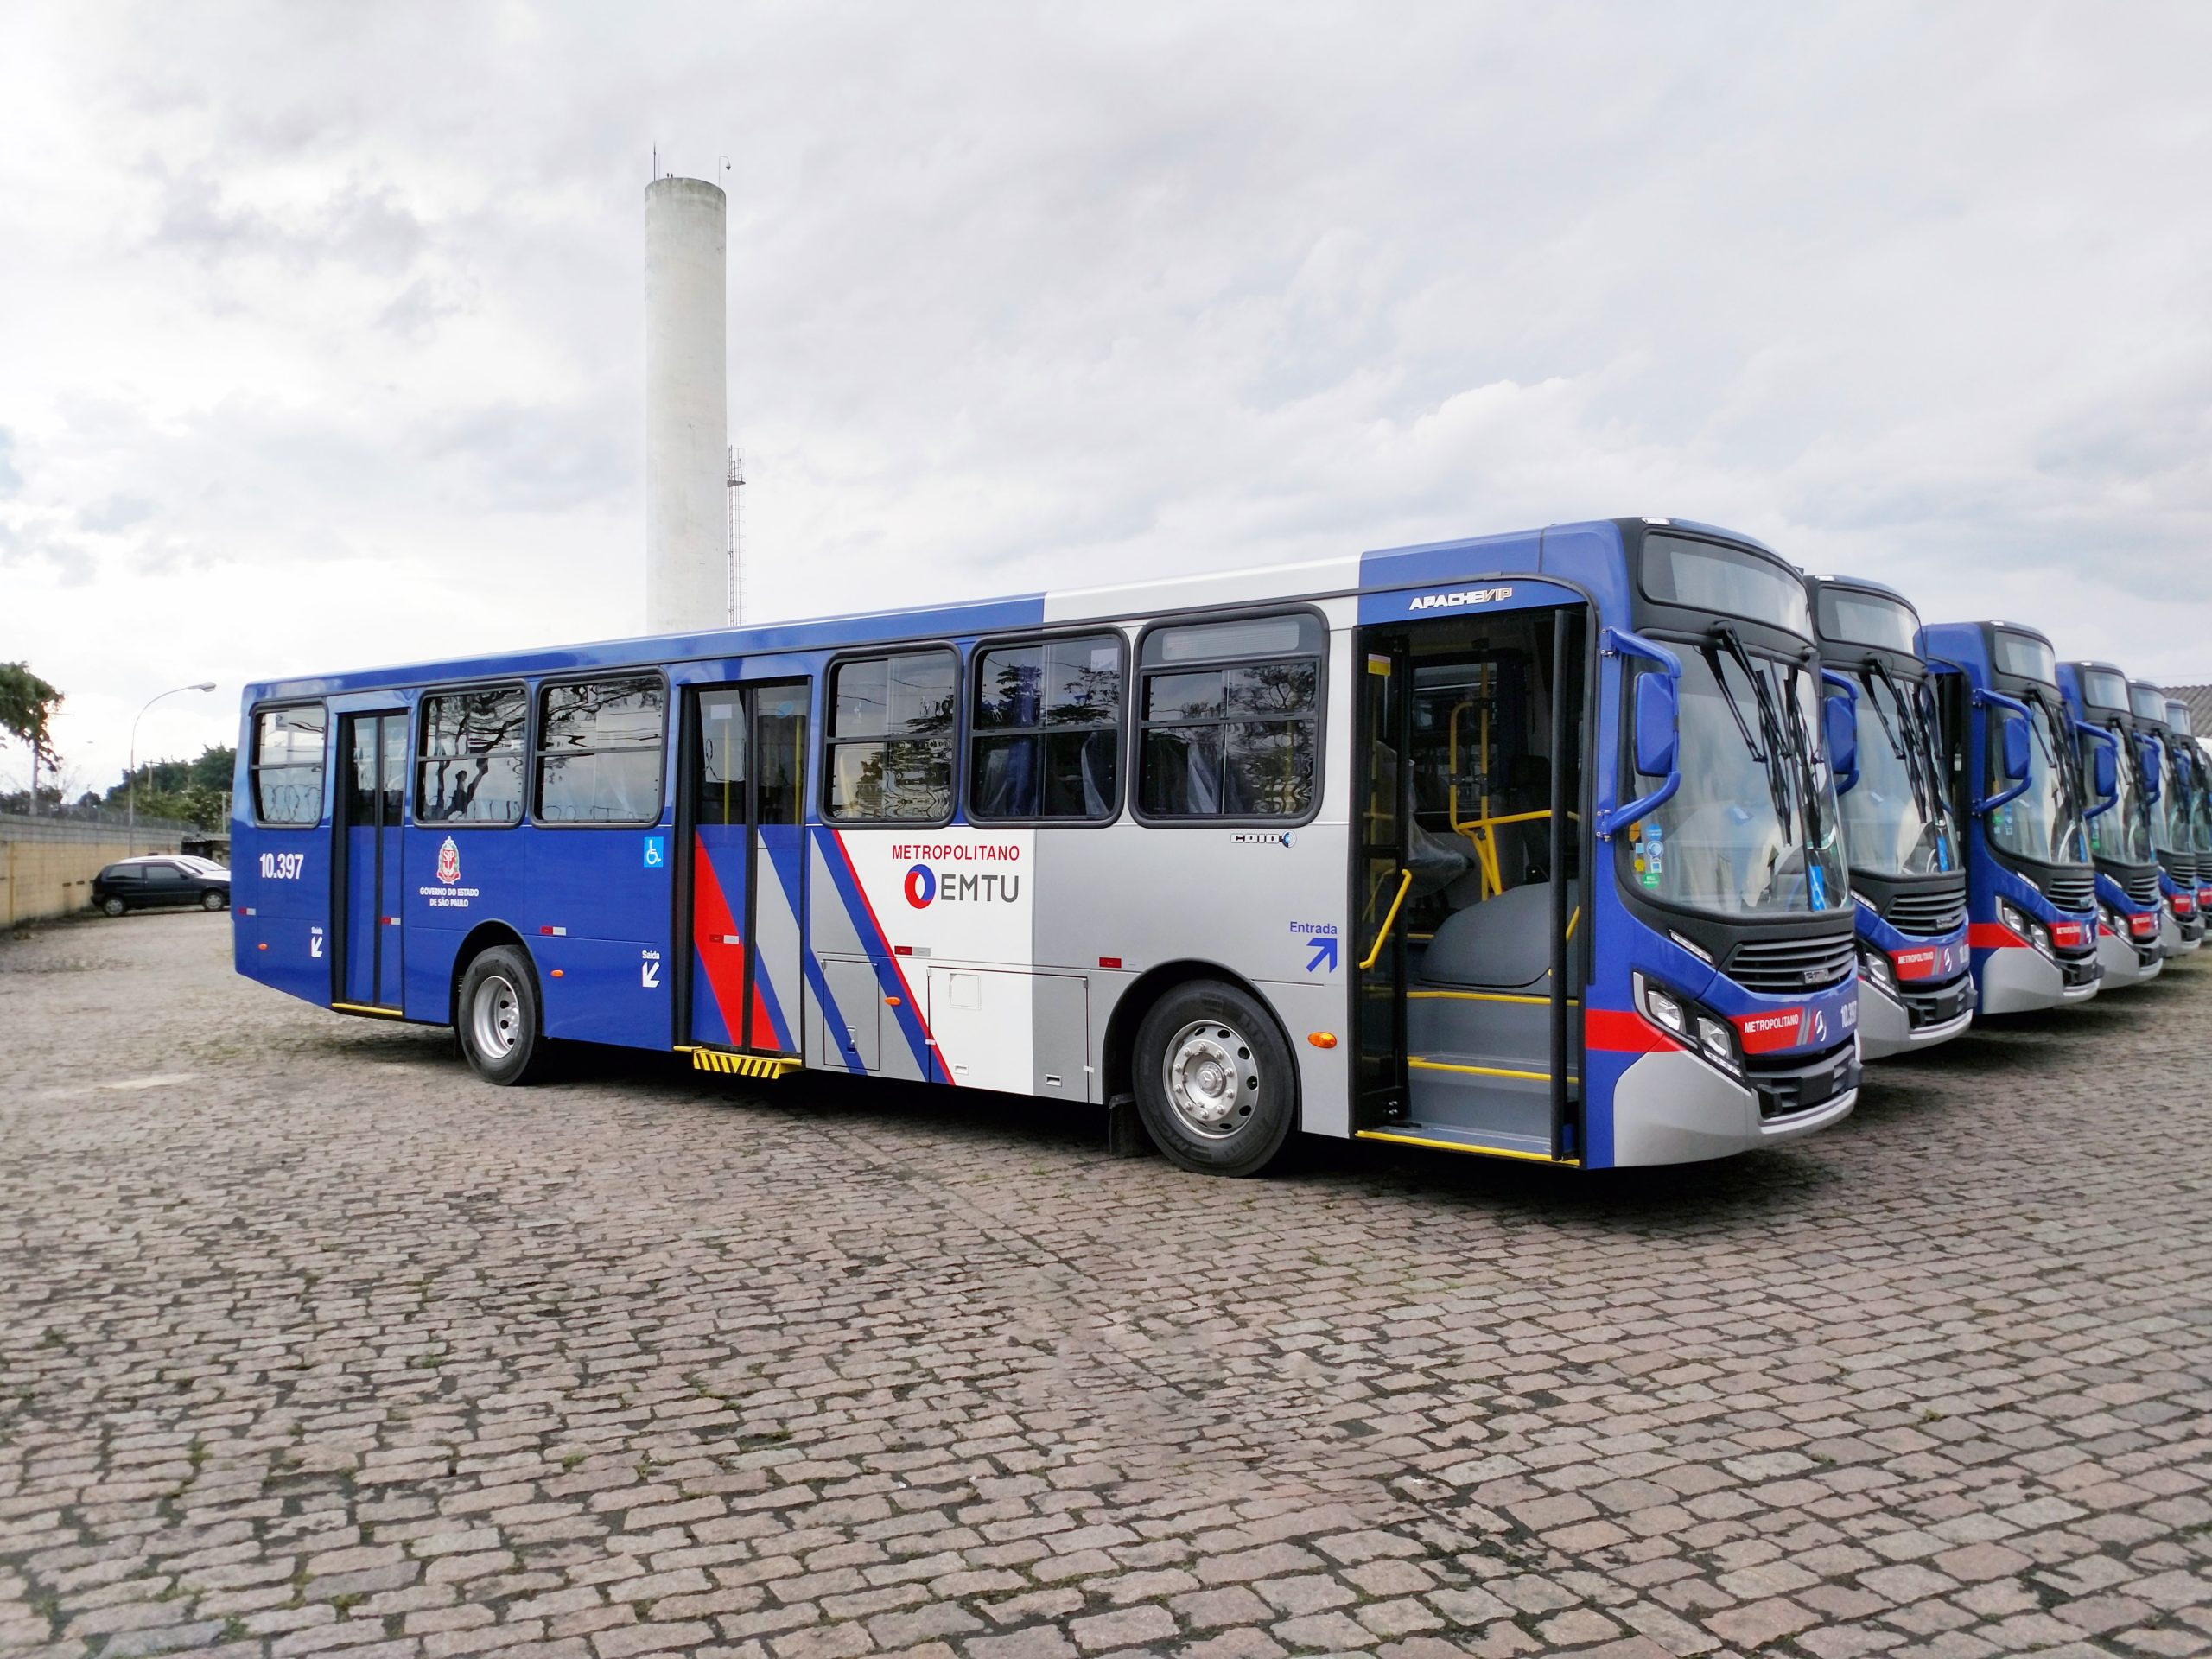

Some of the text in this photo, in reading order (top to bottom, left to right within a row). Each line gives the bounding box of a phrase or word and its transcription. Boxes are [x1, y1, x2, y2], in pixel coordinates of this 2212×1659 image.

[892, 845, 1020, 861] METROPOLITANO
[259, 853, 303, 880] 10.397
[420, 887, 480, 897] GOVERNO DO ESTADO
[941, 874, 1019, 903] EMTU
[429, 898, 438, 906] DE
[450, 899, 469, 907] PAULO
[1290, 921, 1338, 934] Entrada
[1745, 1014, 1799, 1033] METROPOLITANO
